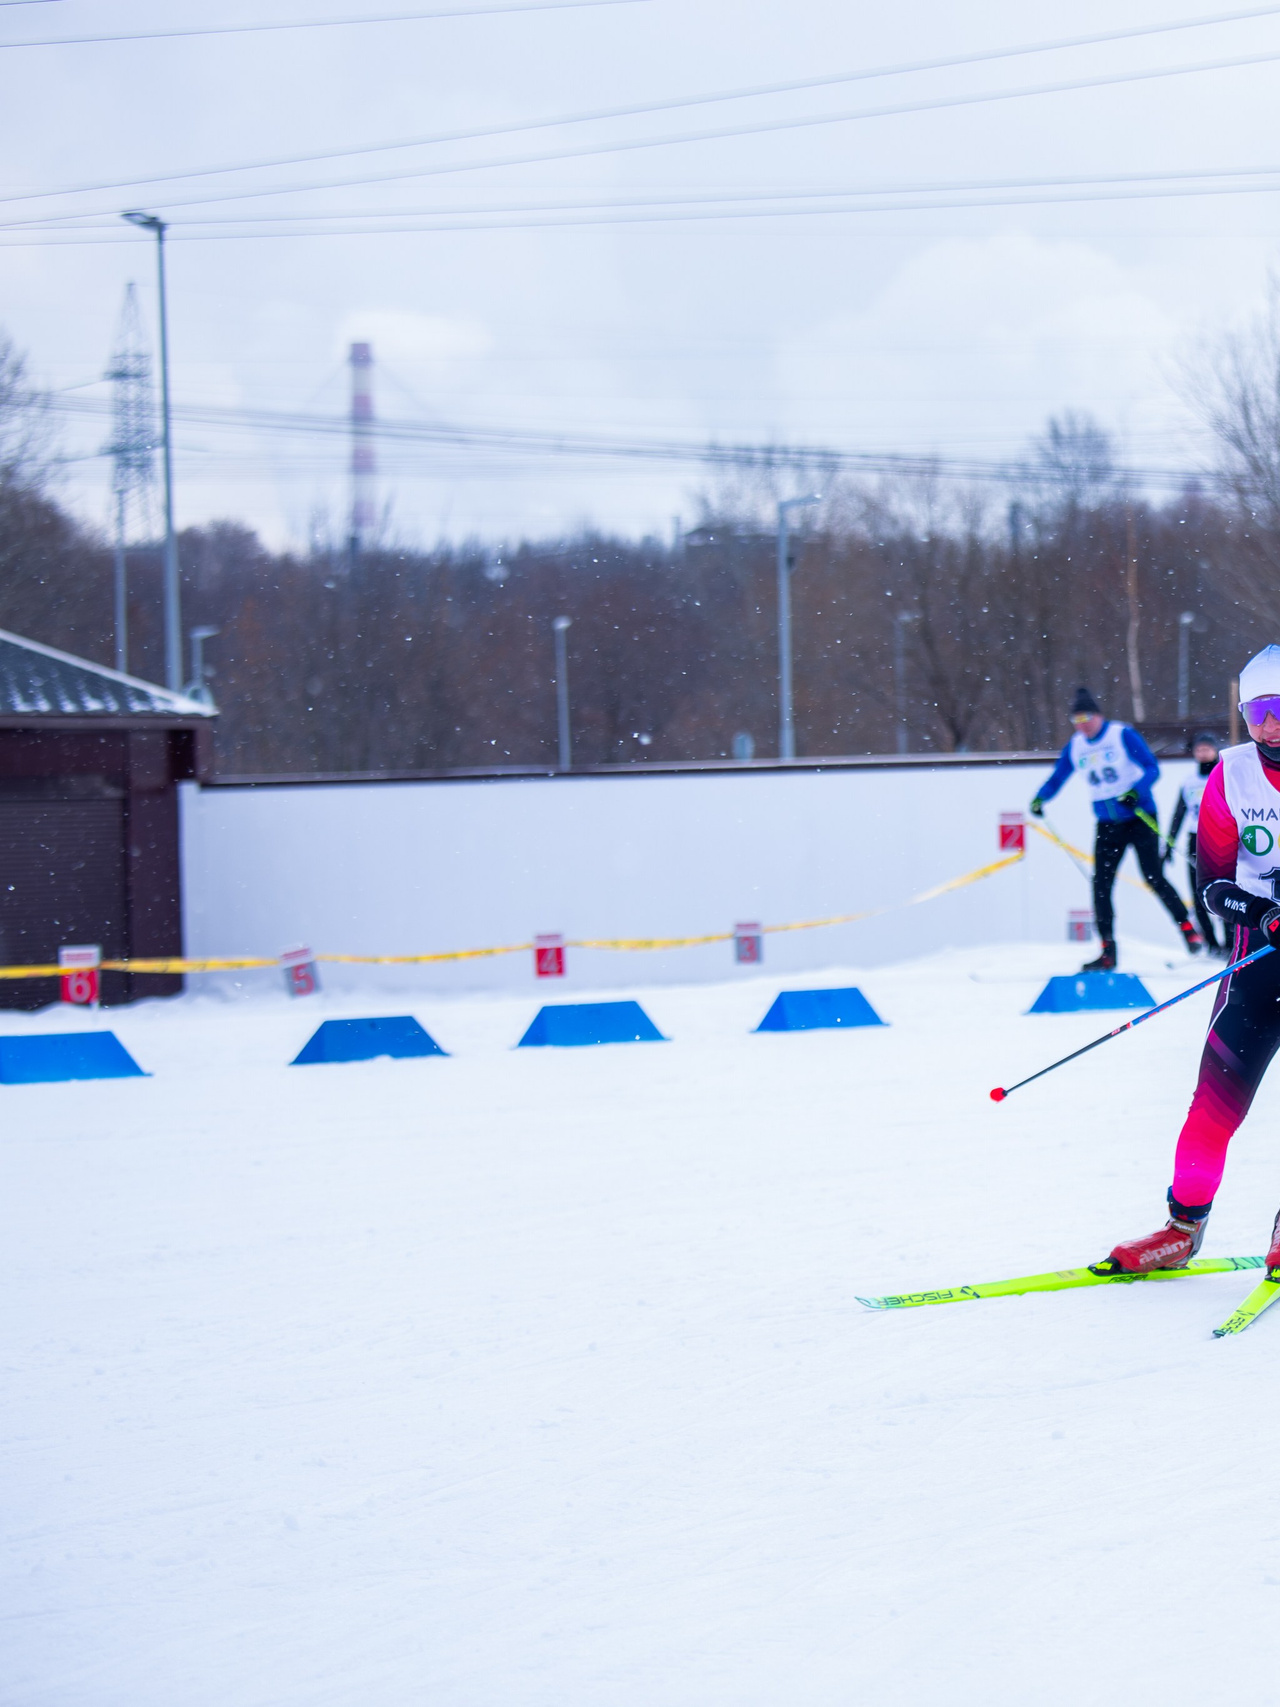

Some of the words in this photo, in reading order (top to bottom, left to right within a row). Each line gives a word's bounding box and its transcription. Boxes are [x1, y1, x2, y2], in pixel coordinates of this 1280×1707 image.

[1002, 824, 1022, 849] 2
[1074, 921, 1086, 942] 1
[540, 948, 562, 975] 4
[739, 936, 758, 963] 3
[68, 971, 91, 1003] 6
[291, 963, 315, 997] 5
